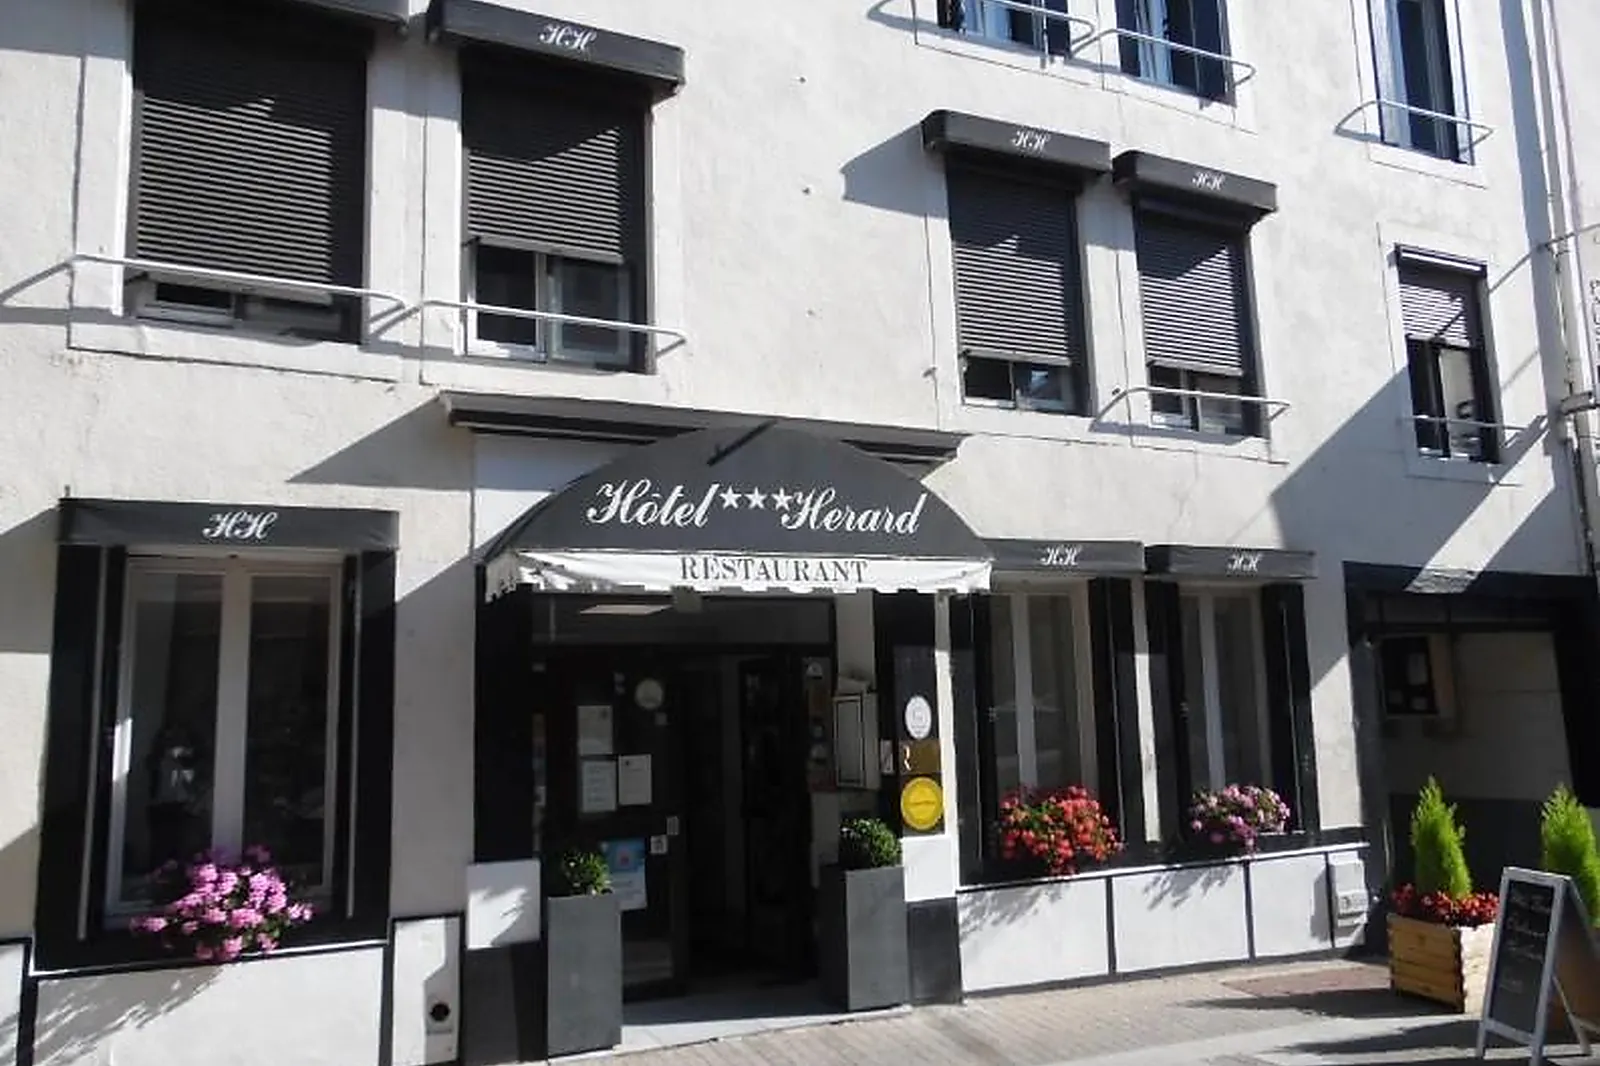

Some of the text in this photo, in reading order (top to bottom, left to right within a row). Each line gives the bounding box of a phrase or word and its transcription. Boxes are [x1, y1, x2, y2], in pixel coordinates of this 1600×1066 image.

[586, 479, 927, 534] Hôtel Herard
[680, 555, 868, 583] RESTAURANT
